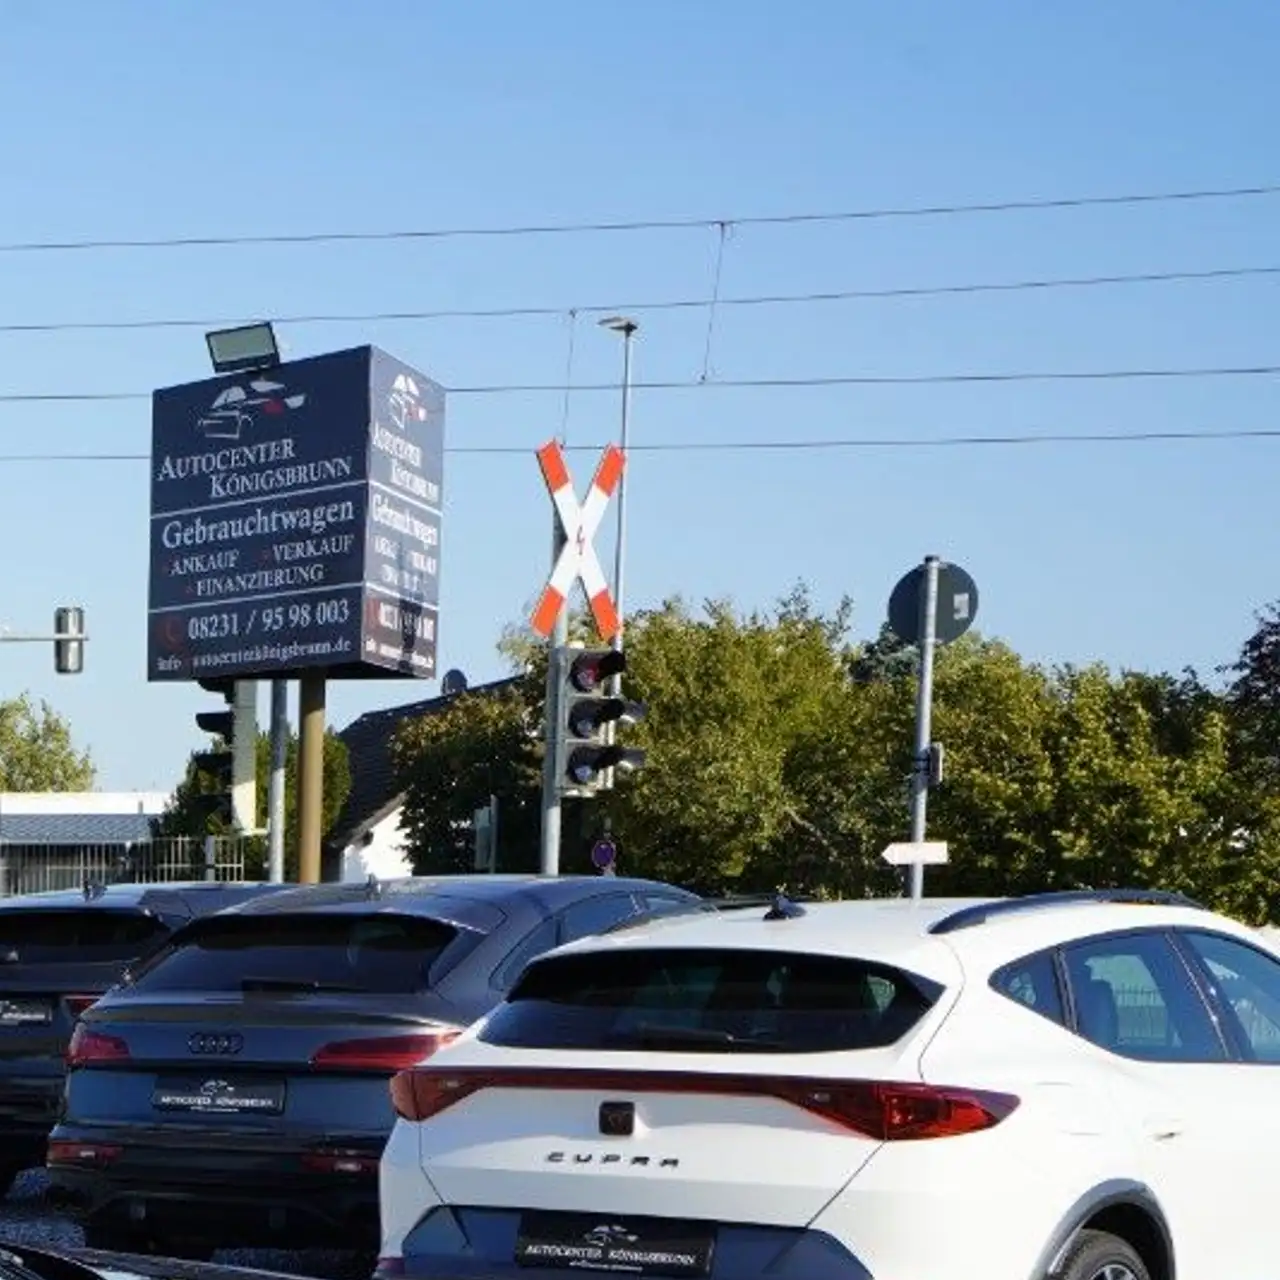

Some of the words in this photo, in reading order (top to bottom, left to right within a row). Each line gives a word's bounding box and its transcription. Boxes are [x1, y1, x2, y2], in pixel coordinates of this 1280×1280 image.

[156, 438, 296, 481] AUTOCENTER
[208, 456, 353, 499] KÖNIGSBRUNN
[162, 500, 355, 549] Gebrauchtwagen
[170, 549, 240, 576] ANKAUF
[272, 534, 355, 563] VERKAUF
[196, 564, 324, 596] FINANZIERUNG
[188, 613, 240, 640] 08231
[245, 609, 258, 635] /
[262, 606, 285, 632] 95
[289, 603, 312, 628] 98
[316, 598, 350, 626] 003
[547, 1151, 679, 1167] CUPRA
